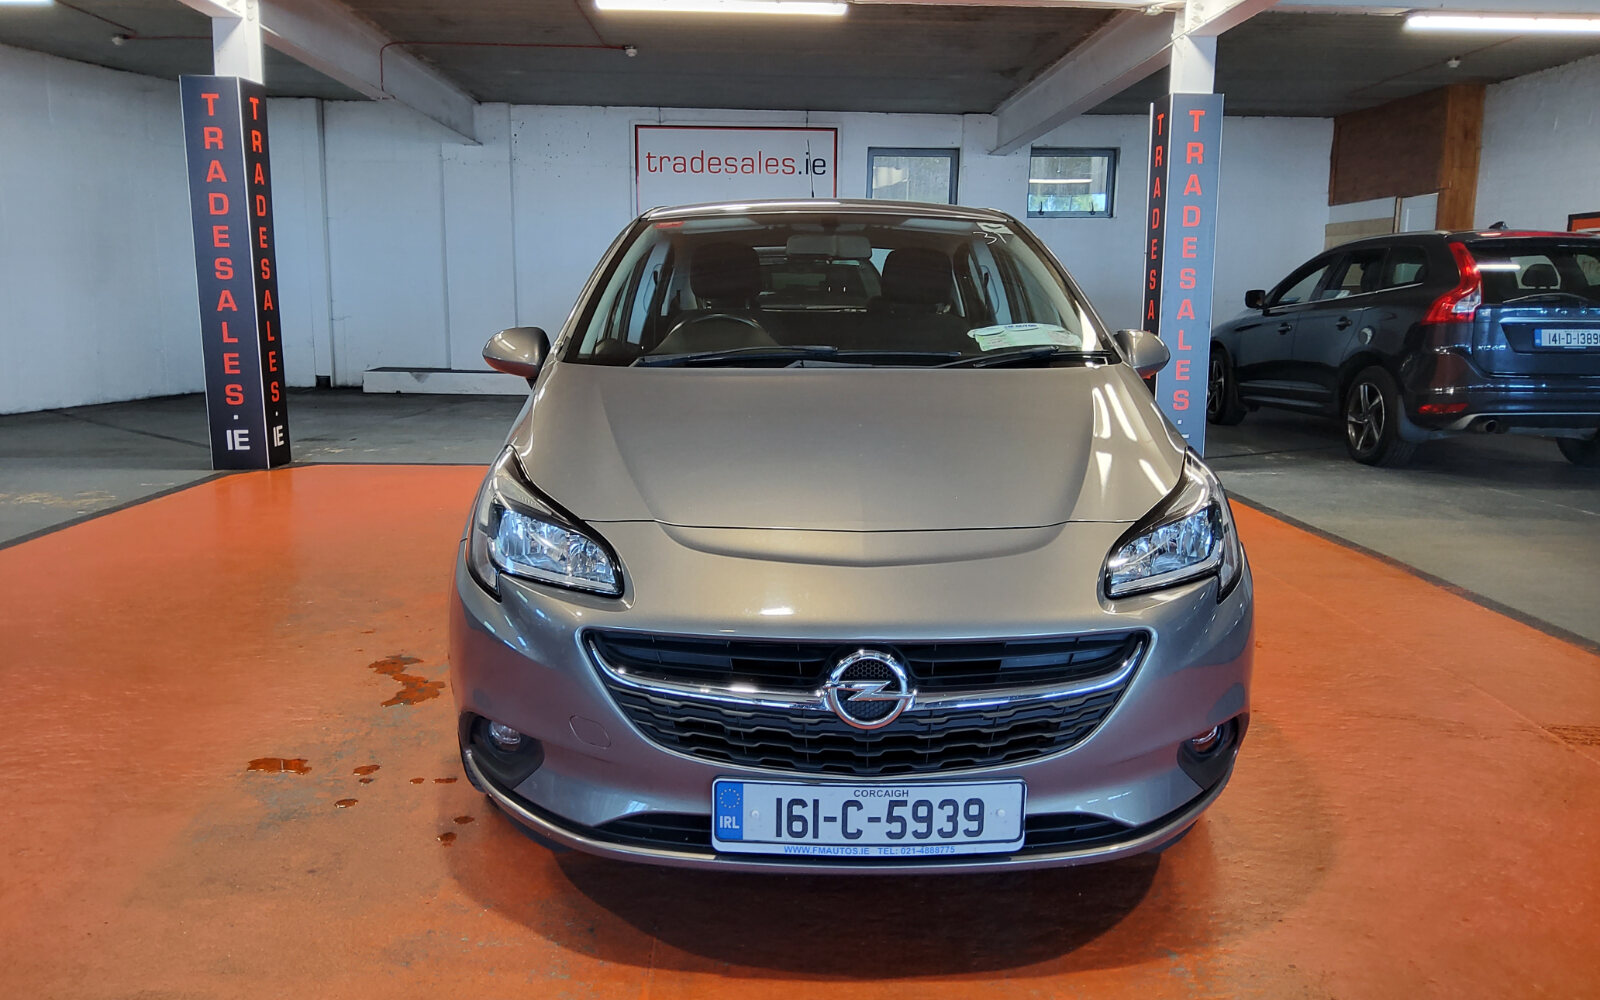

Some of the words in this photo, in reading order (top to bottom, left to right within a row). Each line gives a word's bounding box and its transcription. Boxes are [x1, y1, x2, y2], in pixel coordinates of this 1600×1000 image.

[645, 149, 827, 176] tradesales.ie
[1147, 113, 1165, 334] TRADESA
[201, 93, 251, 451] TRADESALES.IE
[248, 96, 284, 448] TRADESALES.IE
[1172, 110, 1206, 439] TRADESALES.
[853, 788, 909, 798] CORCAIGH
[719, 815, 740, 830] IRL
[775, 797, 985, 840] 161-C-5939
[783, 845, 870, 855] WWW.FMAUTOS.IE
[877, 846, 898, 855] TEL:
